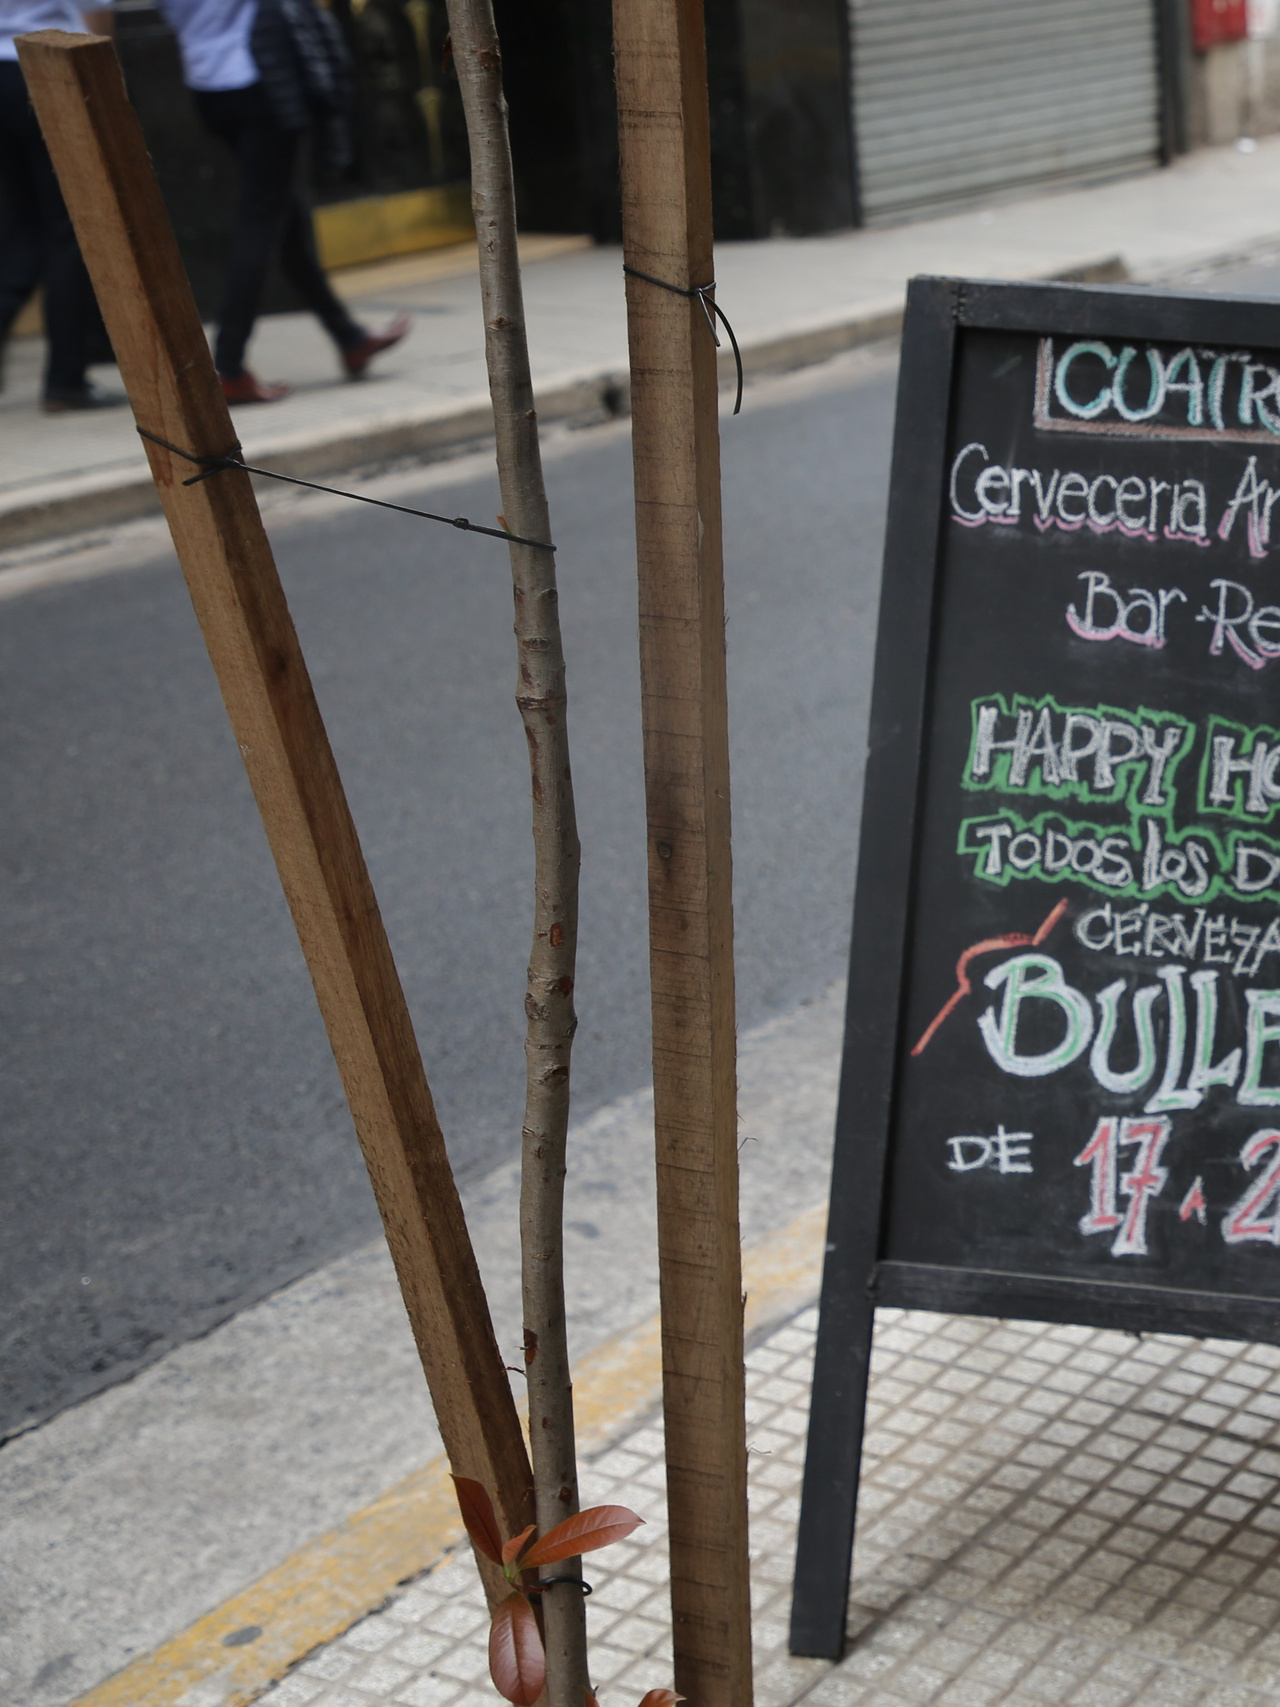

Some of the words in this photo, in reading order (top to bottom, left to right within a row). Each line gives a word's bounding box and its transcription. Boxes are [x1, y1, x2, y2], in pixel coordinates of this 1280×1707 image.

[971, 705, 1183, 805] HAPPY
[946, 1123, 1035, 1175] DE
[1072, 1115, 1174, 1258] 17
